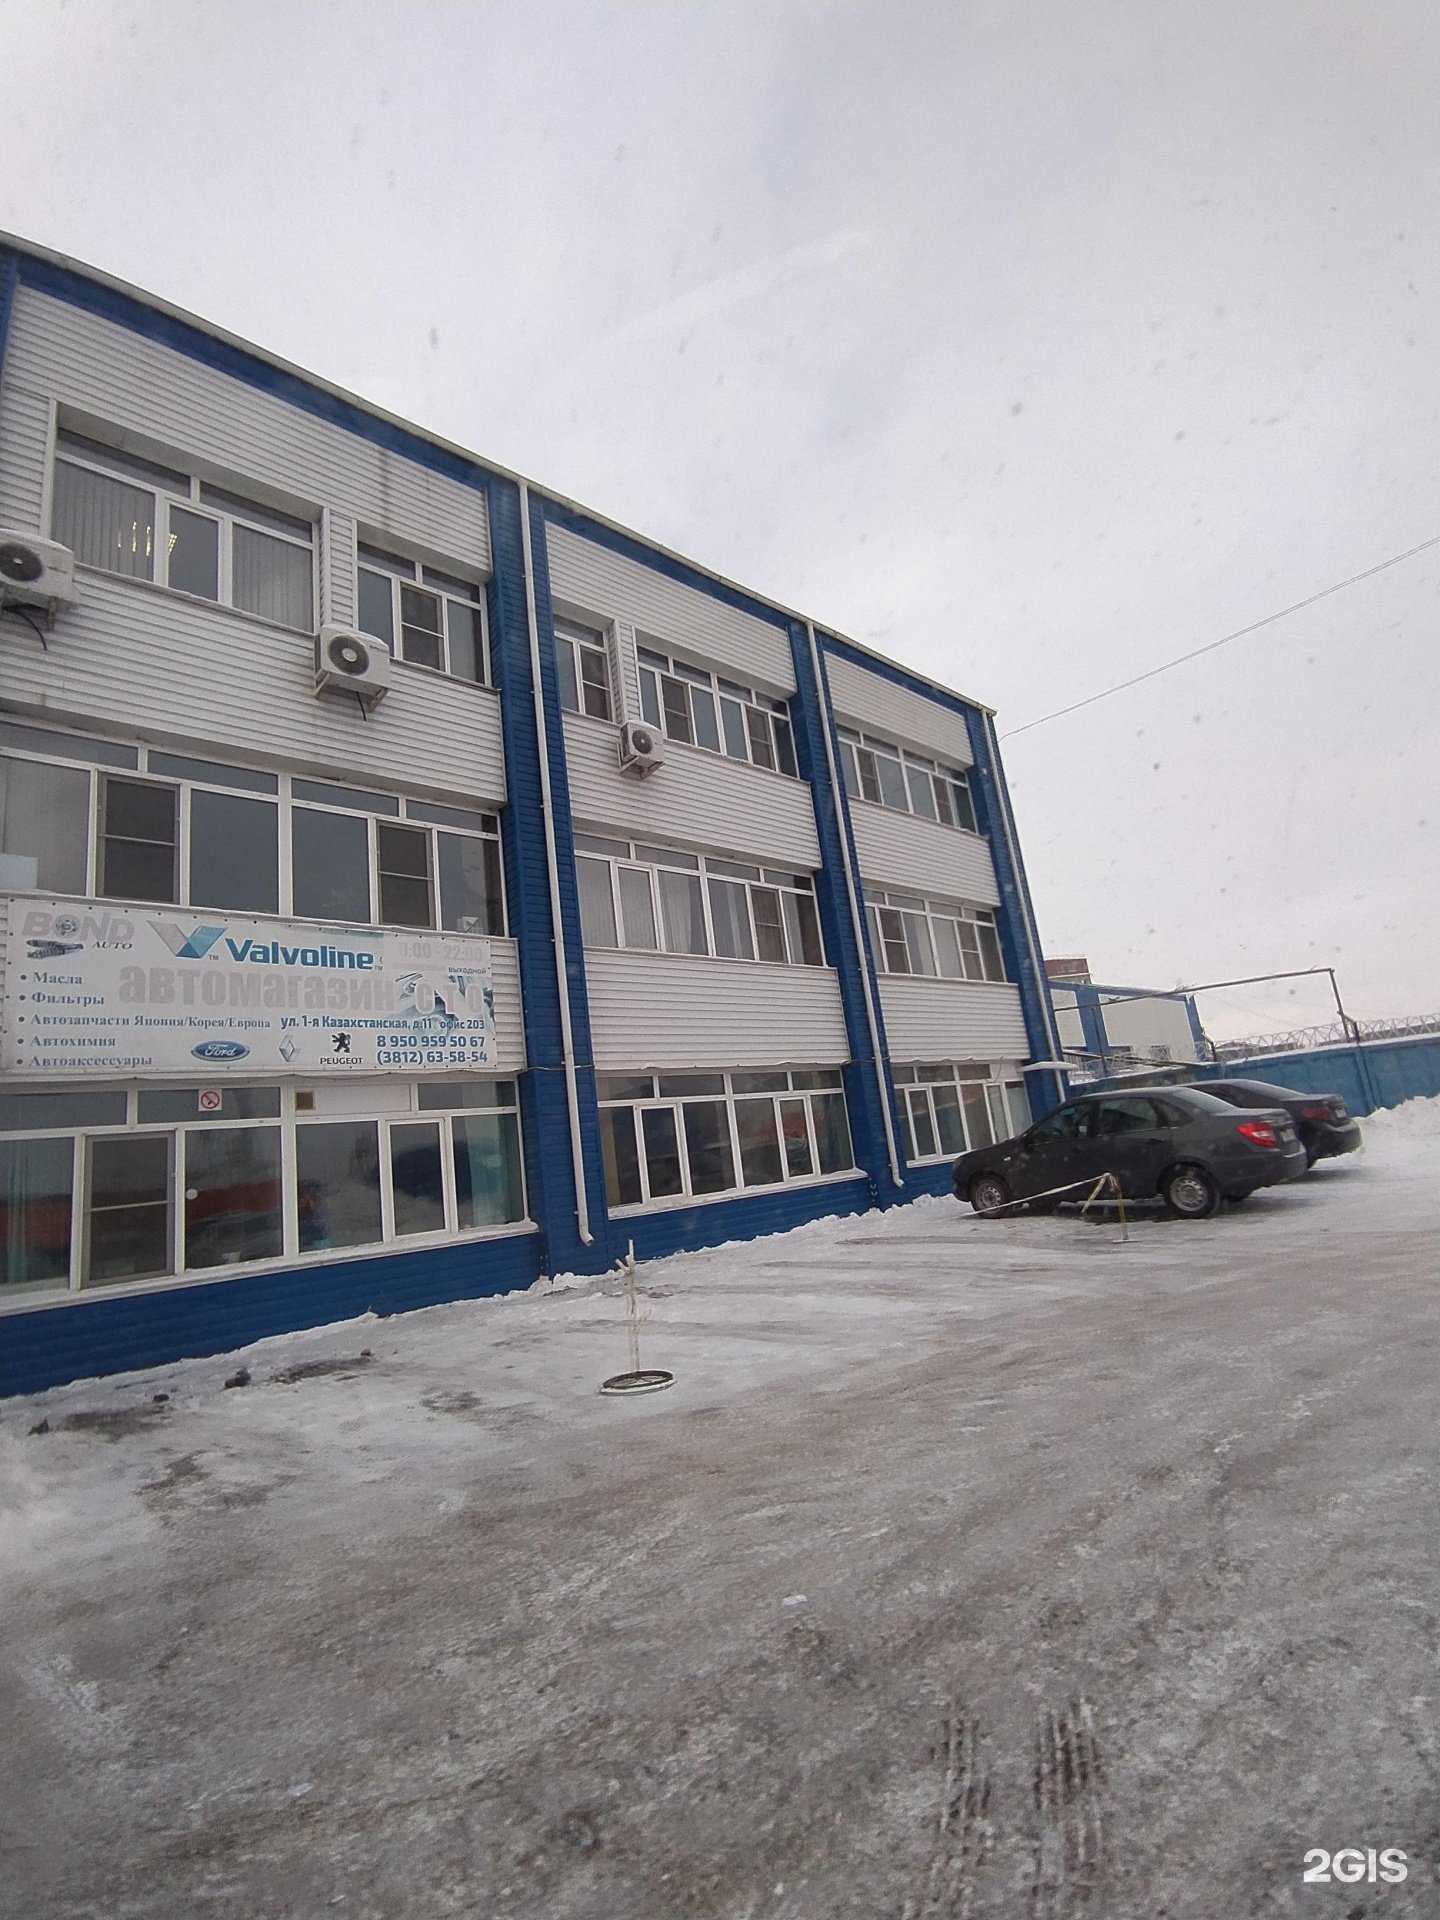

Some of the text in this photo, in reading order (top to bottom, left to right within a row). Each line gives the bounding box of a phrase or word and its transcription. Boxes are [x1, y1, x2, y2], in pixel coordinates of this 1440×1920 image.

[226, 937, 374, 970] Valvoline
[33, 972, 82, 985] Масла
[118, 965, 396, 1012] автомагазин
[31, 992, 104, 1007] Фильтры
[30, 1014, 130, 1026] Автозапчасти
[281, 1017, 299, 1029] ул.
[302, 1015, 319, 1027] 1-я
[322, 1016, 410, 1031] Казахстанская,
[467, 1020, 485, 1030] 203
[30, 1035, 116, 1047] Автохимия
[377, 1036, 485, 1048] 8 950 959 50 67
[204, 1043, 237, 1058] Ford
[28, 1053, 152, 1067] Автоаксессуары
[320, 1057, 363, 1065] PEUGEOT
[377, 1051, 488, 1065] (3812) 63-58-54
